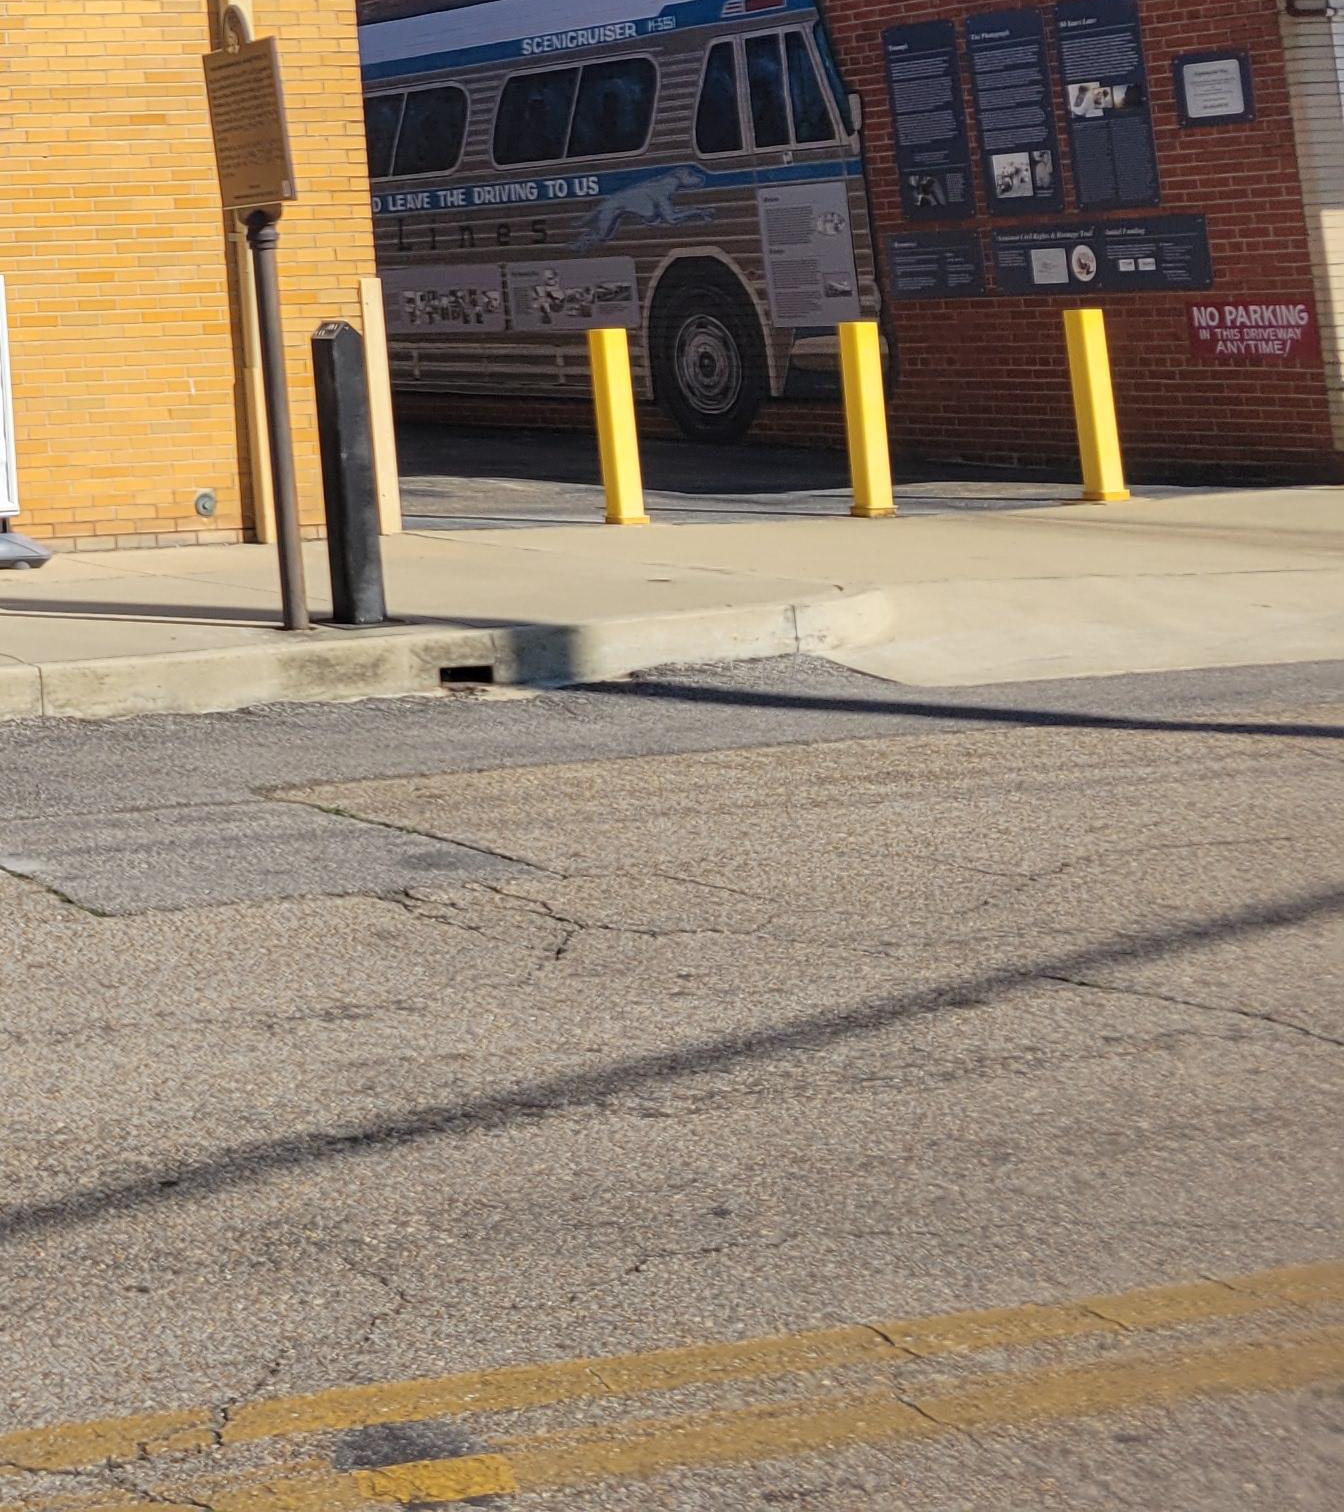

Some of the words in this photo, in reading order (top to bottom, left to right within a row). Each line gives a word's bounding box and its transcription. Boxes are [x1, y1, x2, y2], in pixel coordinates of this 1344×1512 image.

[521, 22, 638, 55] SCENICRUISER
[388, 192, 431, 211] LEAVE
[437, 189, 467, 207] THE
[473, 181, 538, 205] DRIVING
[544, 179, 568, 198] TO
[573, 176, 599, 196] US
[1193, 306, 1220, 327] NO
[1223, 304, 1309, 326] PARKING
[1199, 328, 1211, 340] IN
[1214, 328, 1241, 340] THIS
[1243, 327, 1302, 340] DRIVEWAY
[1215, 339, 1292, 357] ANYTIME!
